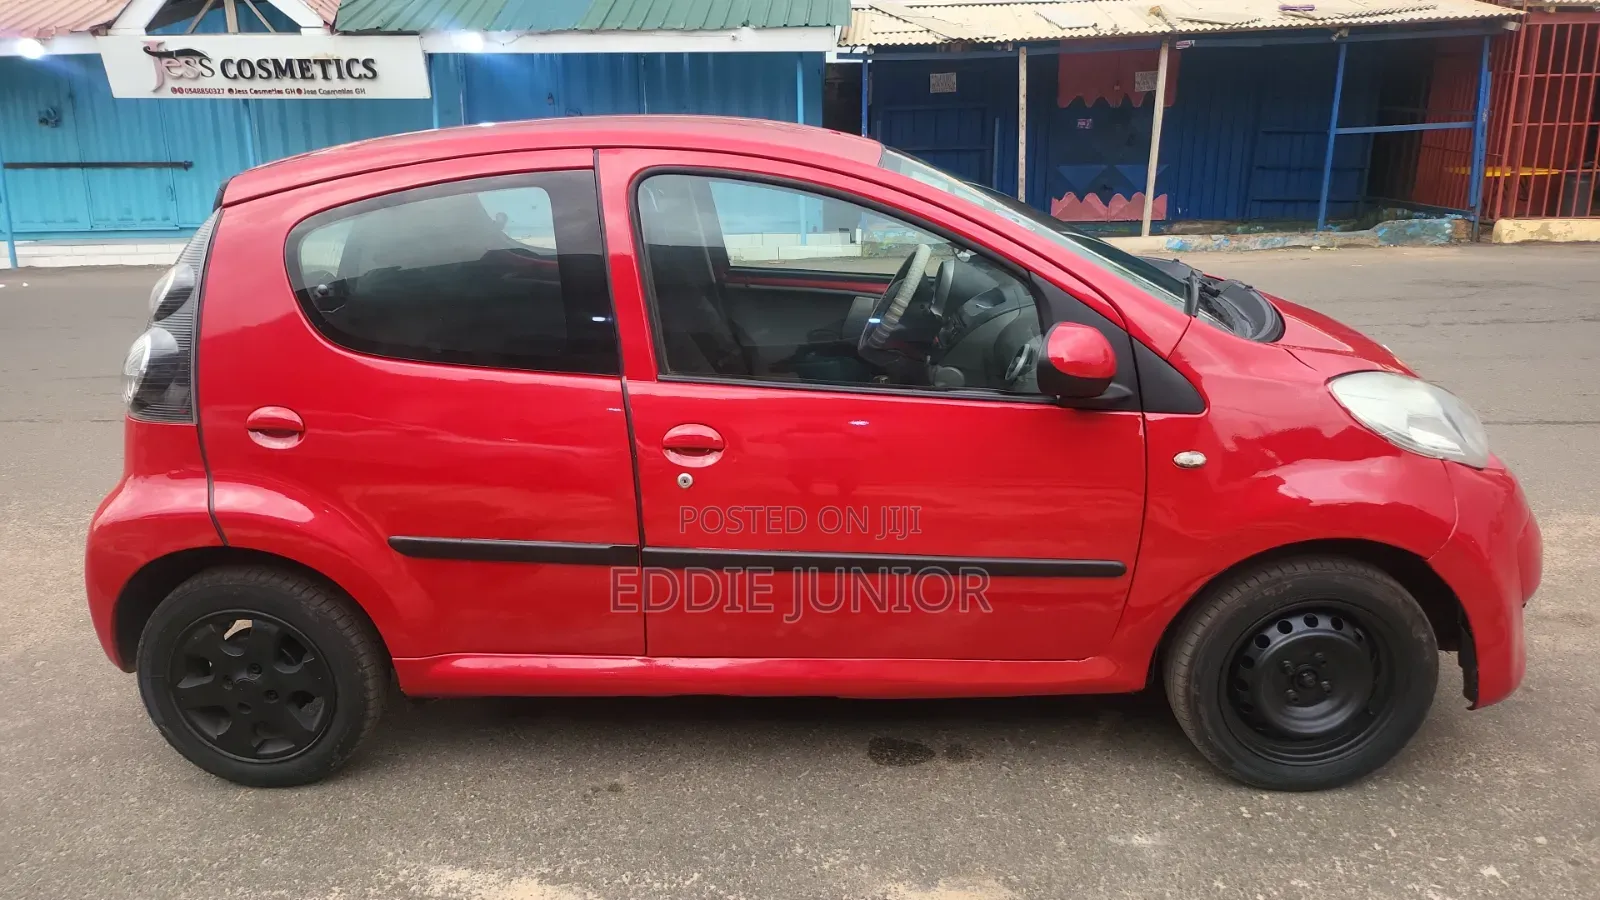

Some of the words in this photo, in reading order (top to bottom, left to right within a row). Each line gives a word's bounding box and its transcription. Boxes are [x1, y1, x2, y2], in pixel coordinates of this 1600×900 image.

[220, 58, 378, 80] COSMETICS
[284, 87, 296, 95] GH
[354, 87, 366, 95] GH
